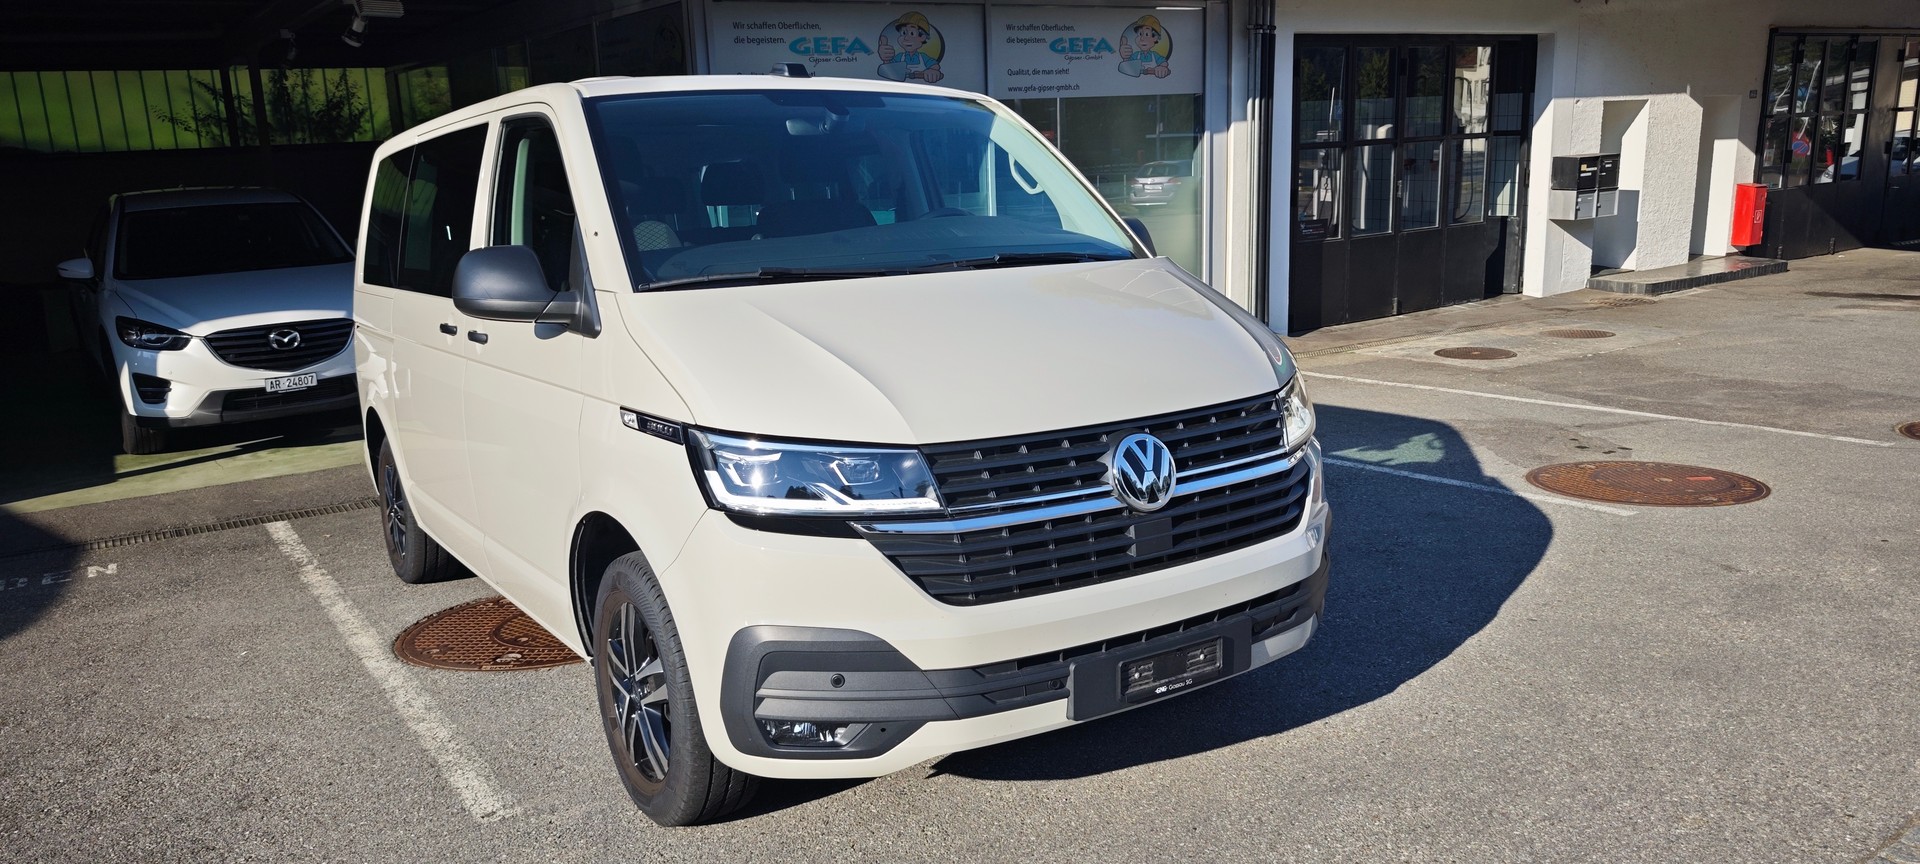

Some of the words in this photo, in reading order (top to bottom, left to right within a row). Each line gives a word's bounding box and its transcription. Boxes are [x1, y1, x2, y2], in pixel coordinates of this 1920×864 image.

[732, 21, 745, 30] Wir
[746, 21, 777, 30] schaffen
[1005, 23, 1016, 31] Wir
[1016, 23, 1041, 32] schaffen
[733, 35, 747, 44] die
[788, 36, 874, 56] GEFA
[1048, 37, 1116, 55] GEFA
[1031, 67, 1041, 76] die
[1055, 67, 1070, 75] sieht!
[1007, 83, 1080, 94] www.gefa-gipser-gmbh.ch
